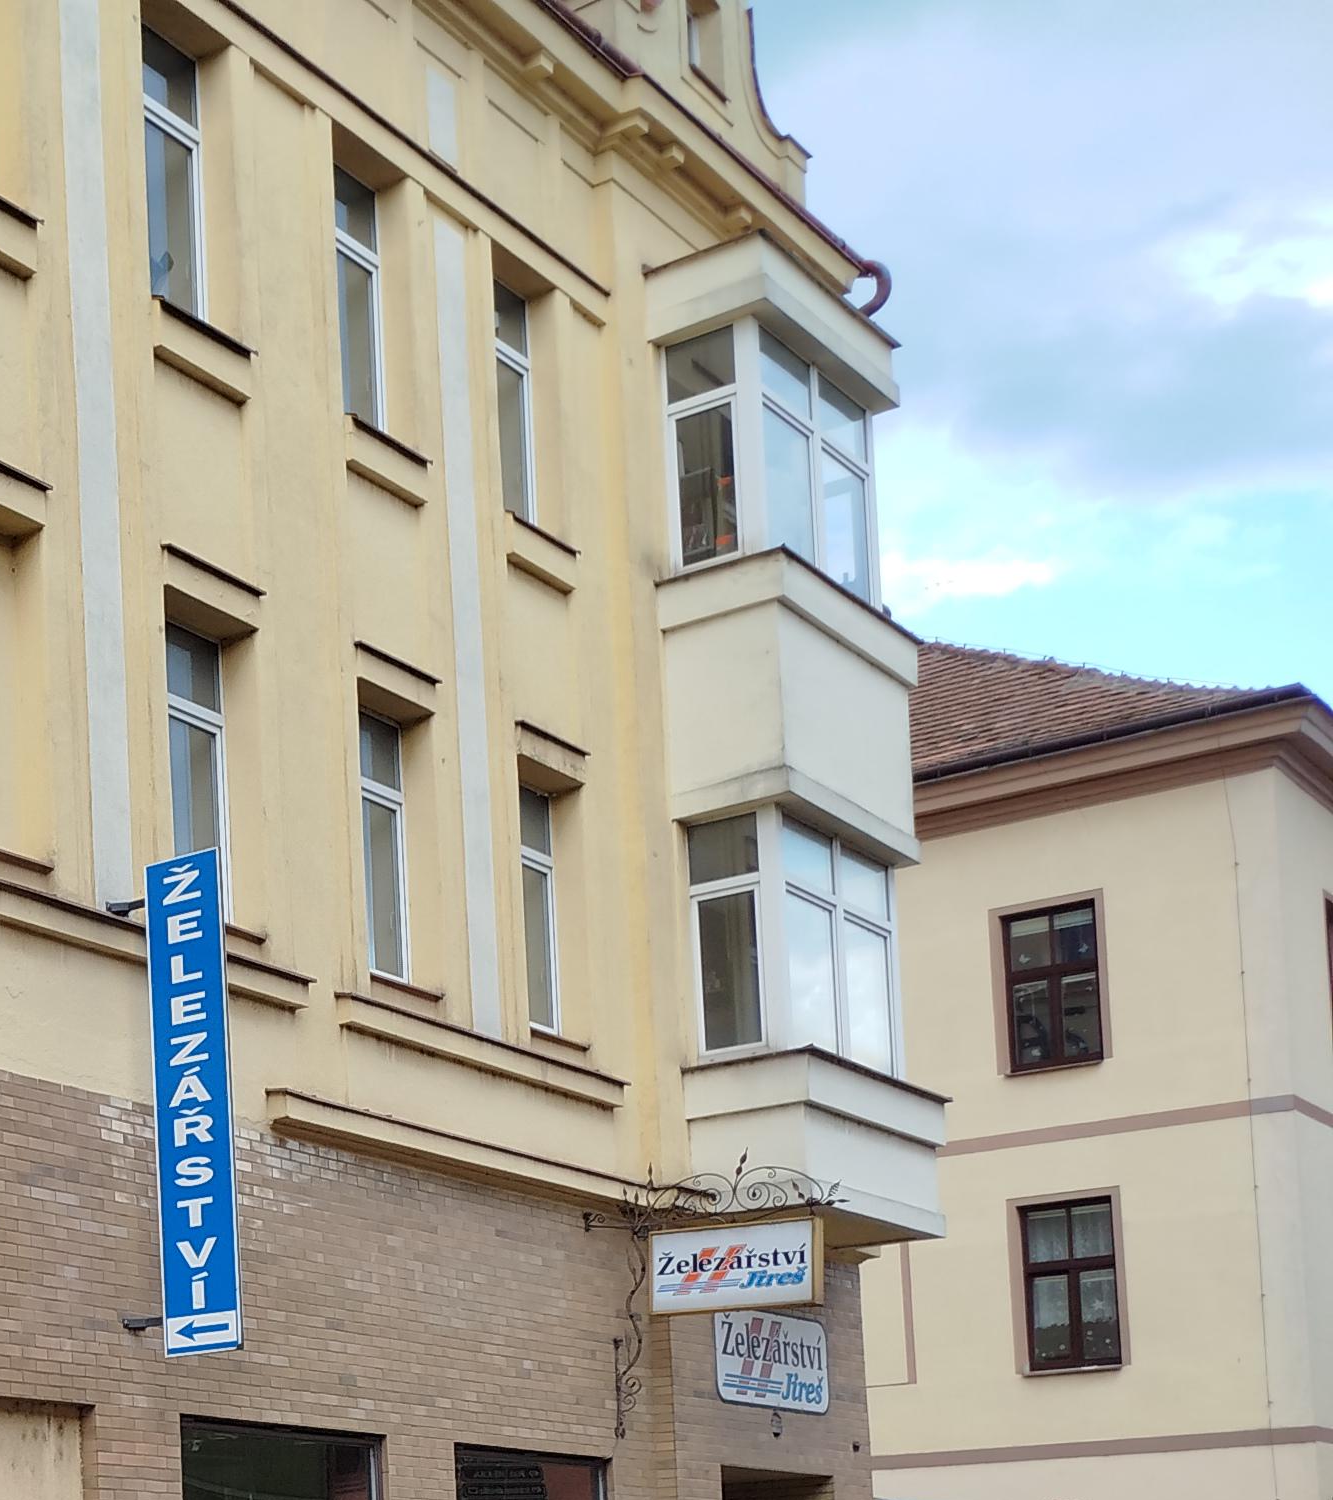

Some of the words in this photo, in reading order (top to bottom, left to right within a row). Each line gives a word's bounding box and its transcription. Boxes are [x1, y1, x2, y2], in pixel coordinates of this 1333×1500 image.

[161, 863, 218, 1309] ŽELEZÁŘSTVÍ
[656, 1243, 807, 1276] Železářství
[739, 1265, 808, 1290] Jireš
[720, 1312, 823, 1372] Železářství
[780, 1372, 823, 1405] Jireš
